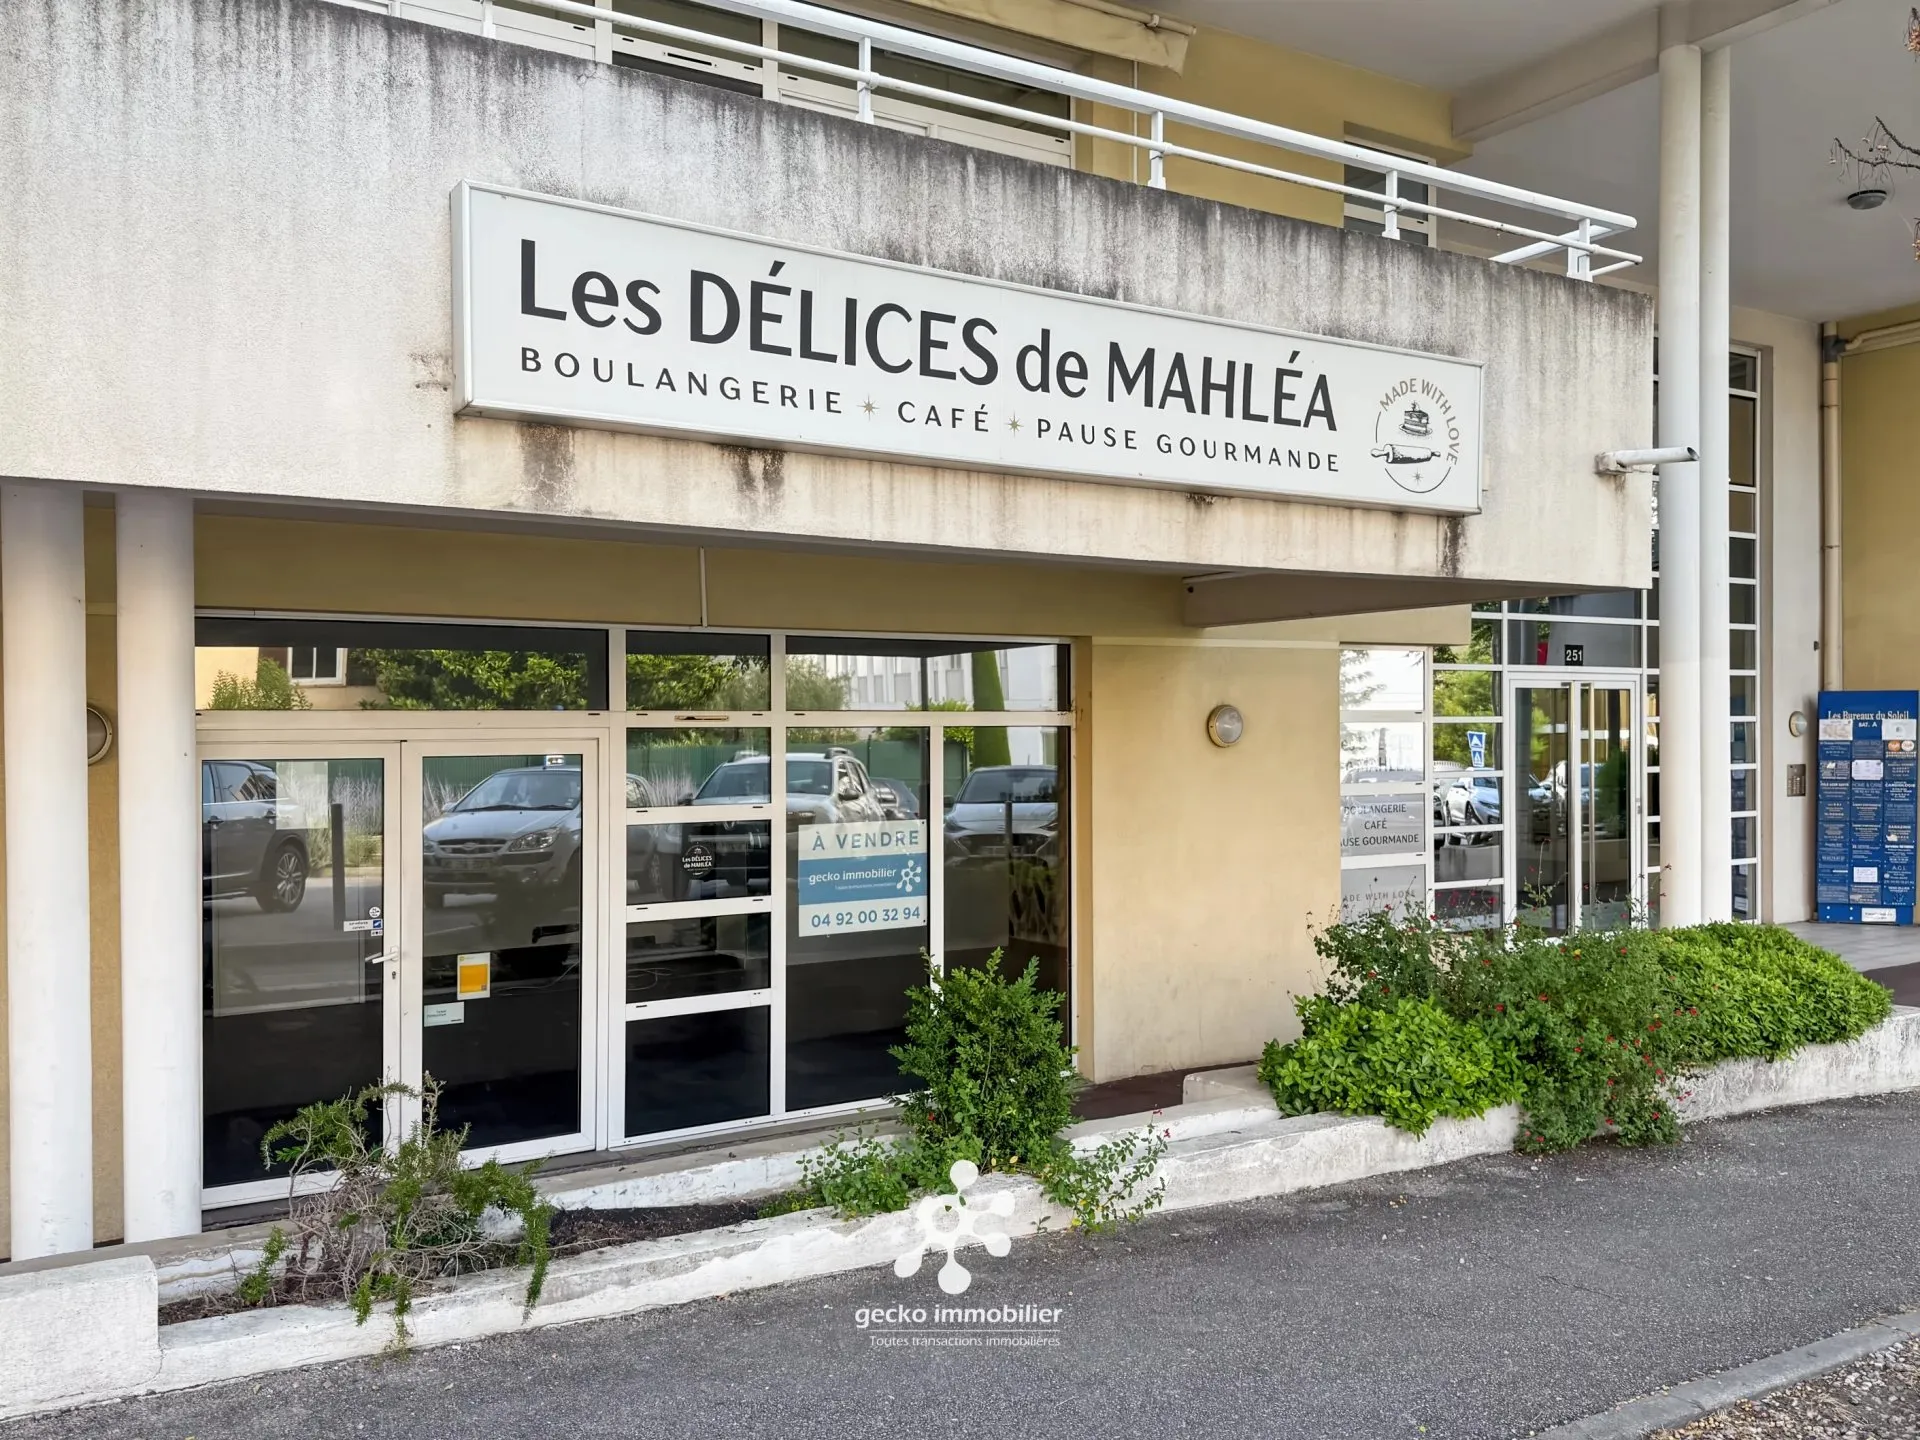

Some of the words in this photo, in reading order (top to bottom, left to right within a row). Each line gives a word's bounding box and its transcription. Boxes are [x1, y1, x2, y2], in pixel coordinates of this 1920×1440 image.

[521, 238, 662, 336] Les
[690, 260, 998, 386] DÉLICES
[1015, 328, 1088, 398] de
[1107, 341, 1338, 432] MAHLÉA
[521, 346, 842, 414] BOULANGERIE
[897, 404, 989, 433] CAFÉ
[1037, 418, 1137, 450] PAUSE
[1157, 434, 1339, 472] GOURMANDE
[1380, 378, 1417, 412] MADE
[1421, 379, 1452, 415] WITH
[1446, 416, 1460, 465] LOVE
[1566, 649, 1582, 661] 251
[1828, 710, 1842, 720] Les
[1843, 710, 1874, 720] Bureaux
[1876, 710, 1886, 720] du
[1888, 710, 1909, 720] Soleil
[1364, 818, 1388, 830] CAFÉ
[812, 831, 825, 851] À
[836, 830, 919, 849] VENDRE
[1341, 838, 1360, 847] USE
[1362, 834, 1420, 846] GOURMANDE
[808, 872, 840, 885] gecko
[842, 868, 896, 880] immobilier
[812, 914, 831, 928] 04
[836, 912, 853, 926] 92
[858, 910, 878, 924] 00
[882, 908, 898, 922] 32
[903, 906, 920, 920] 94
